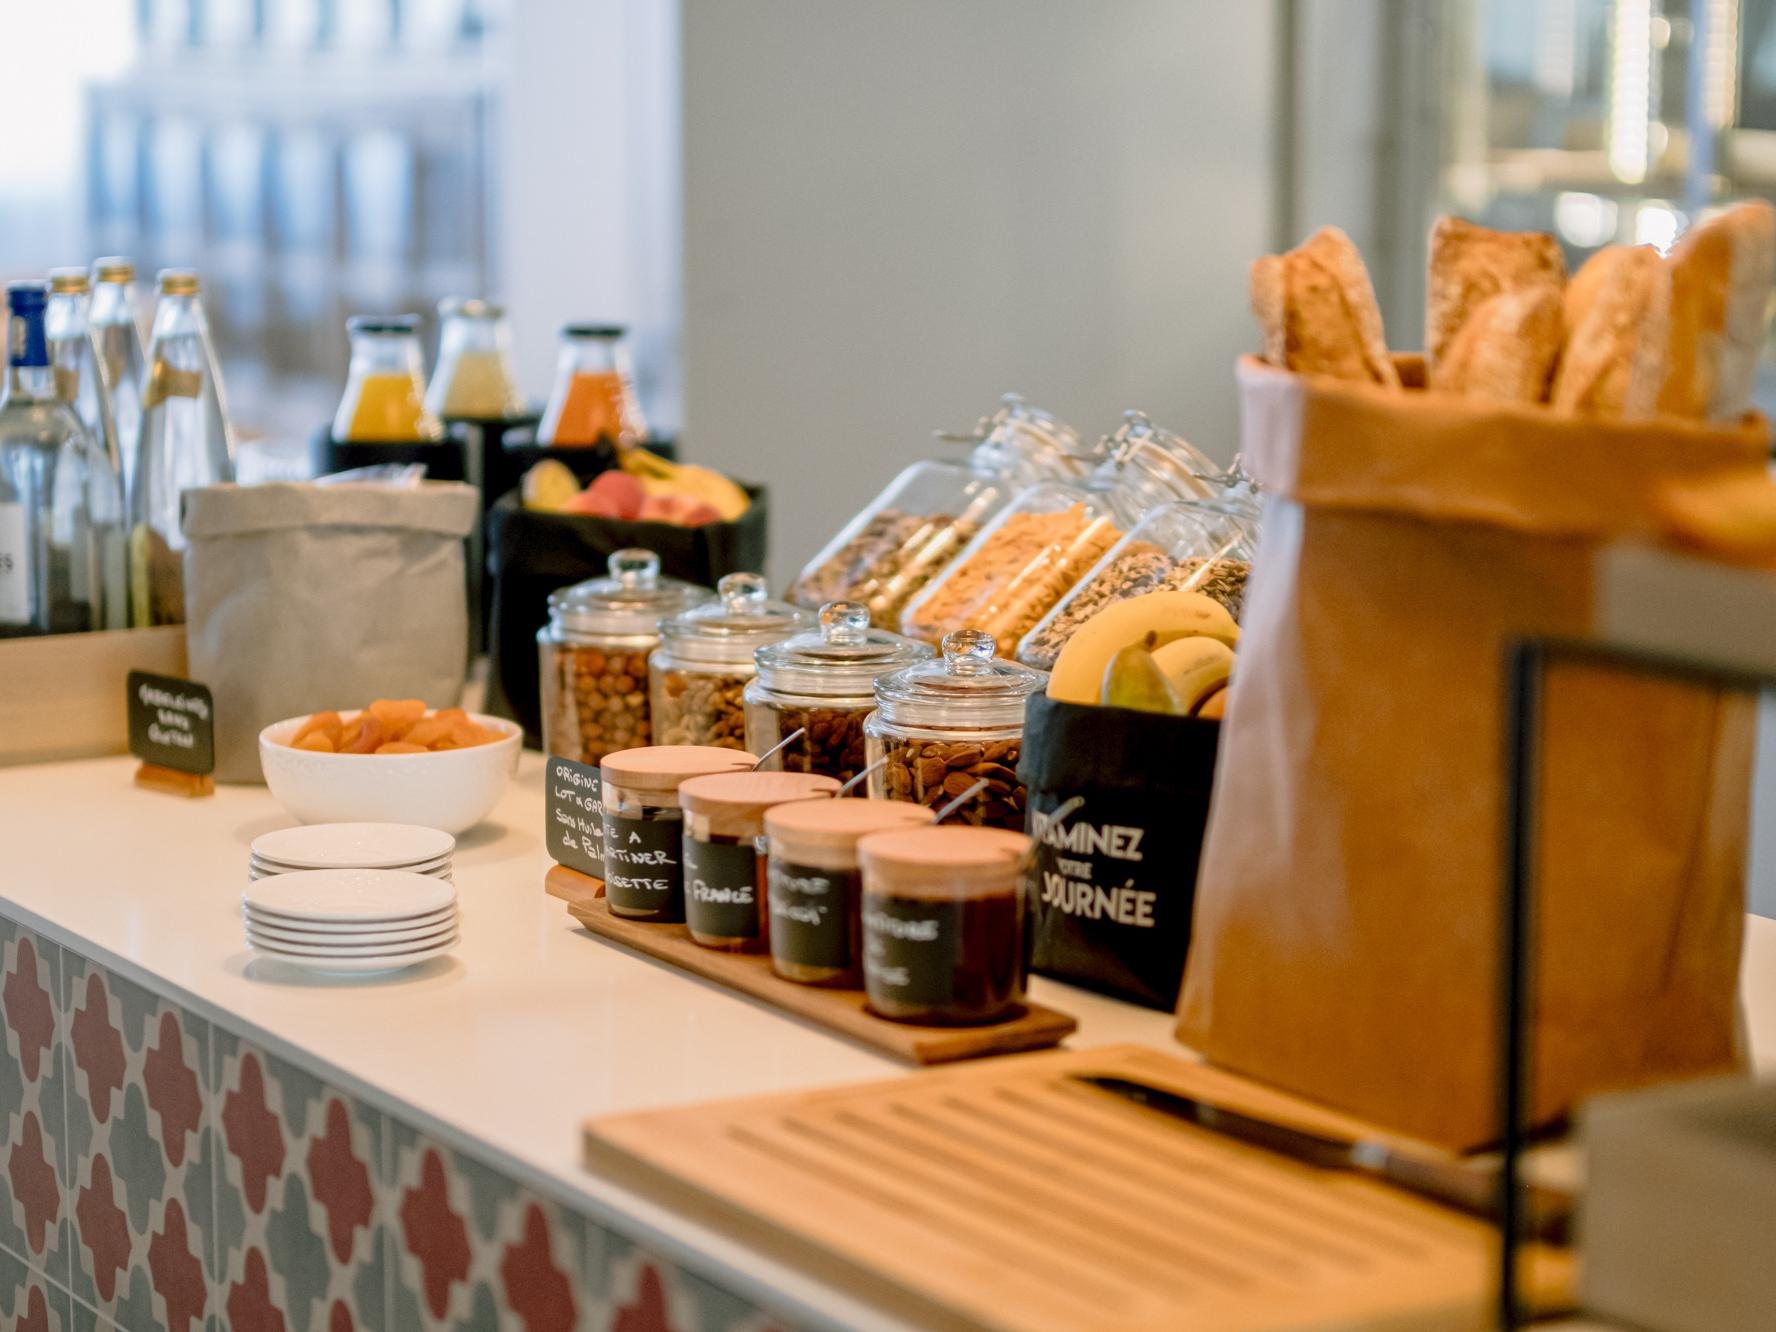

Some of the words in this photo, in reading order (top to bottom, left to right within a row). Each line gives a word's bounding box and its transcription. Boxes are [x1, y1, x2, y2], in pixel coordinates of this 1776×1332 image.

[555, 785, 576, 802] LOT
[628, 831, 642, 844] A
[1041, 871, 1157, 928] JOURNÉE
